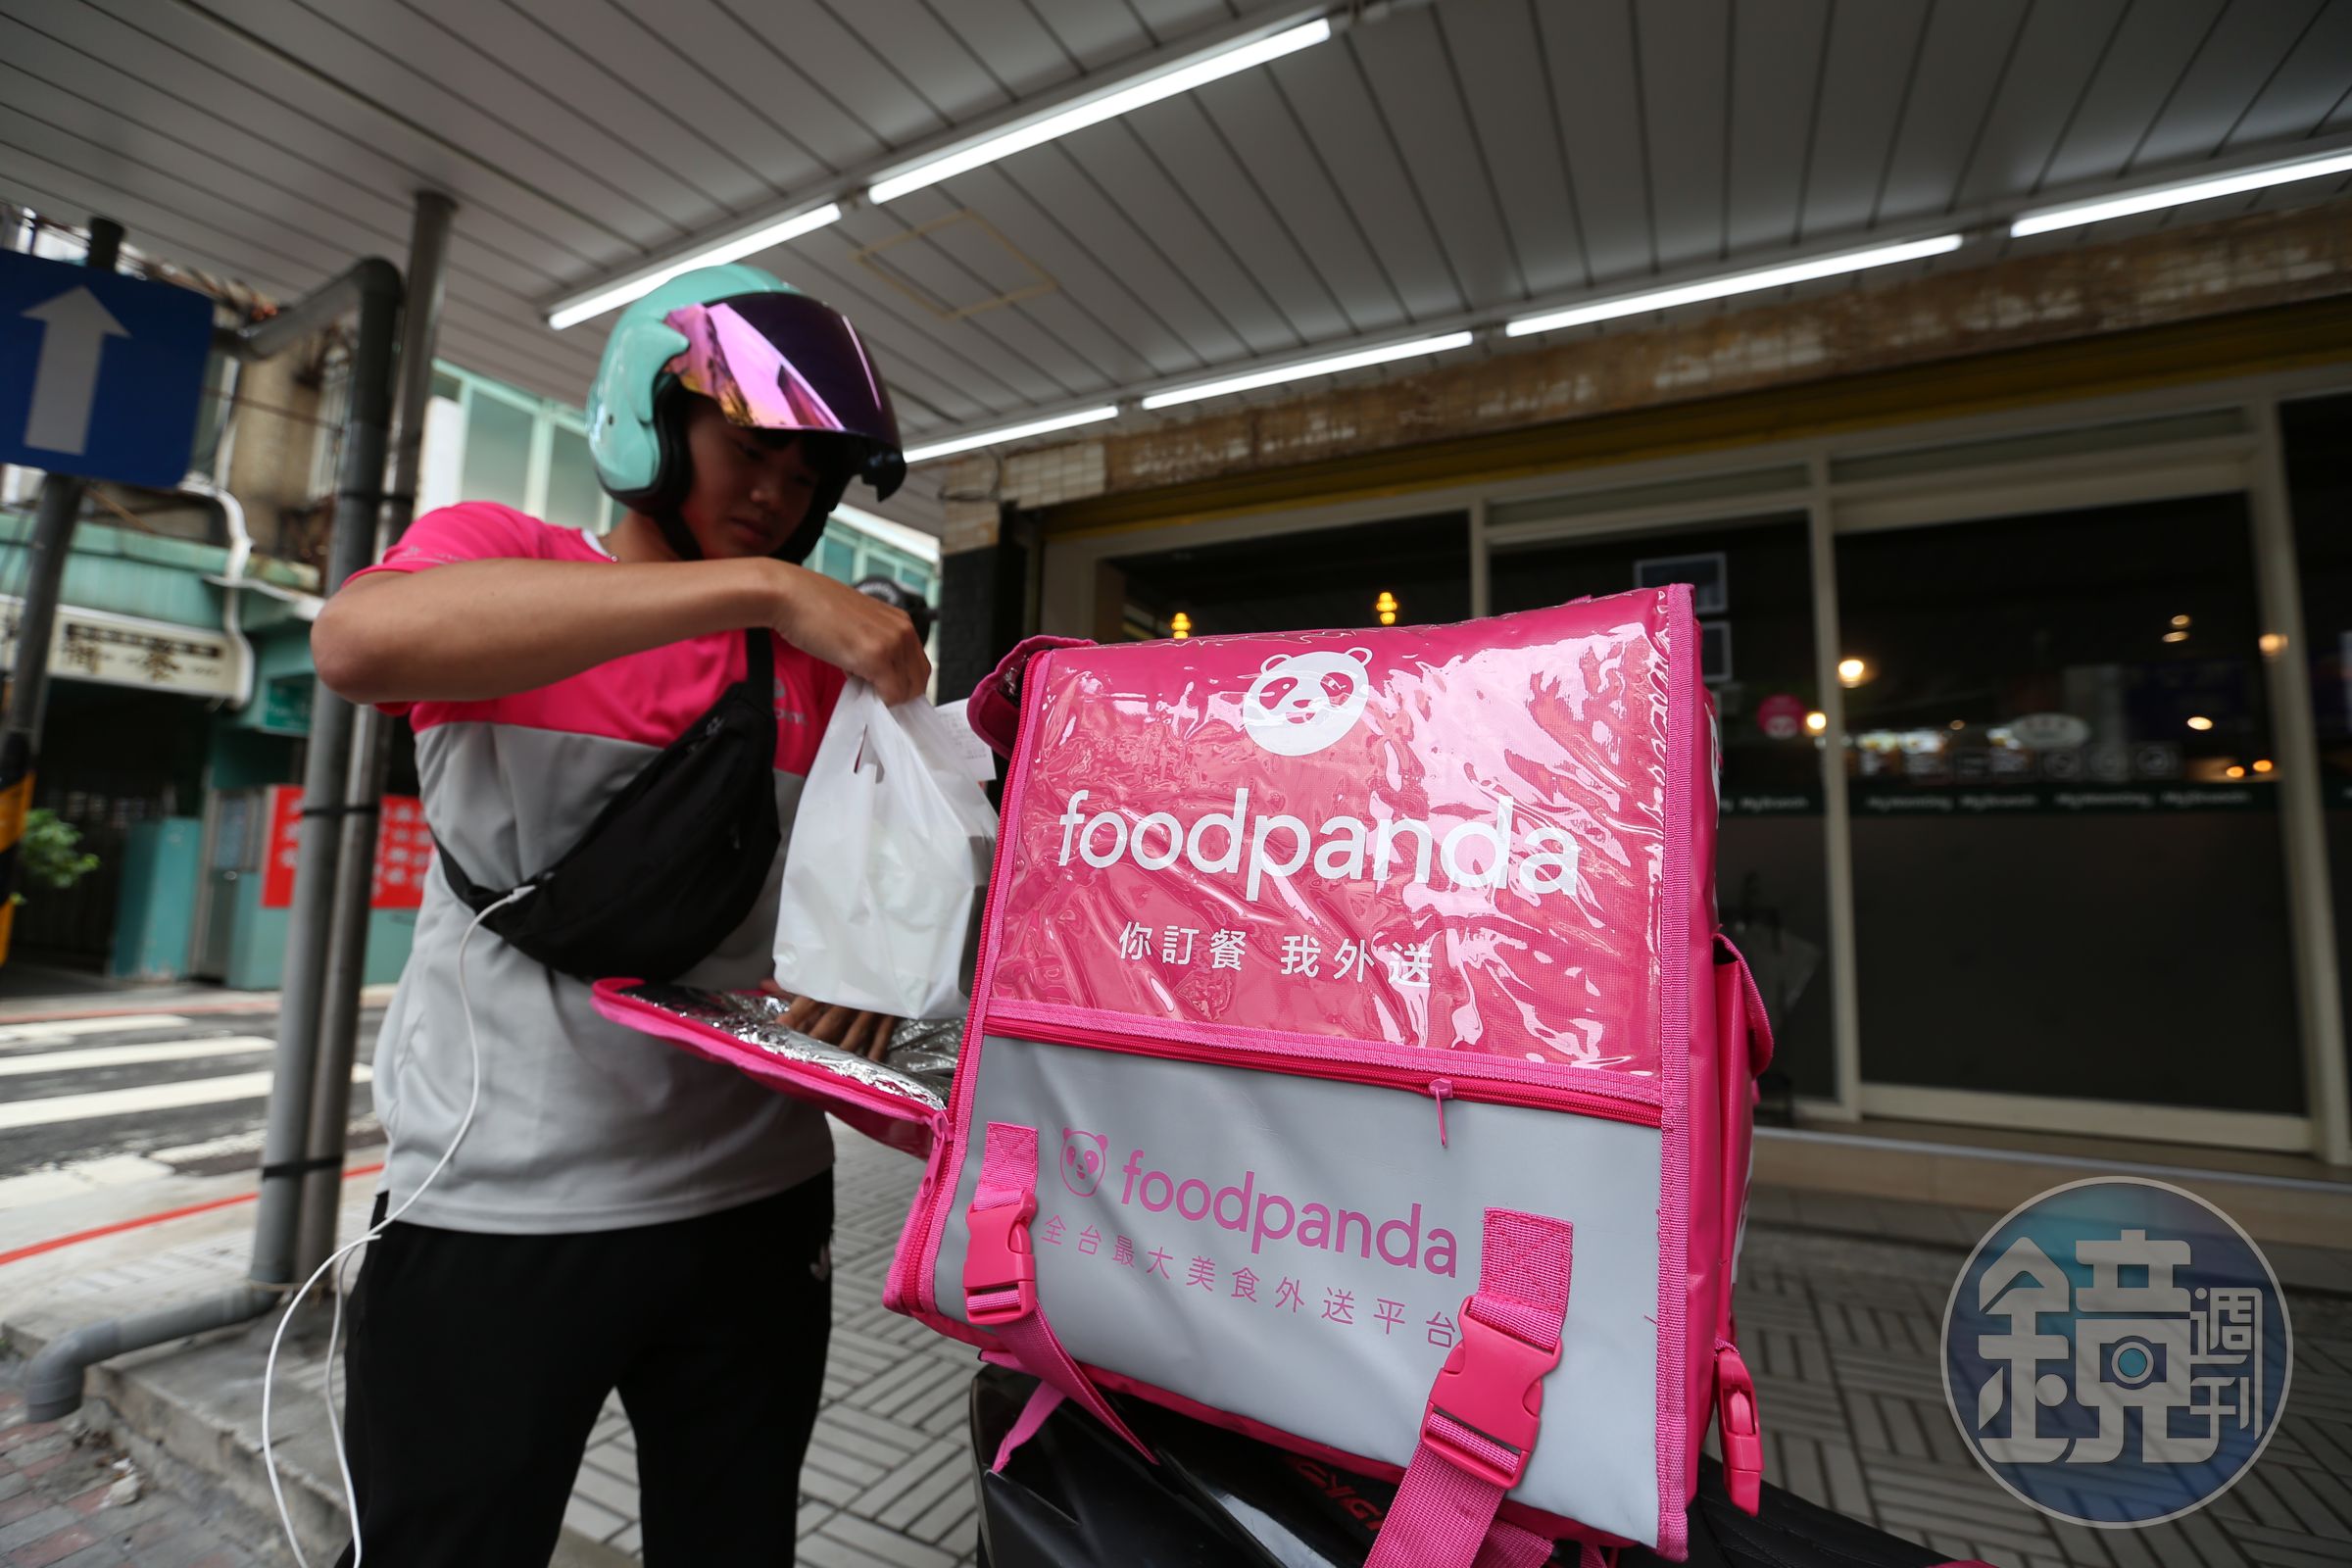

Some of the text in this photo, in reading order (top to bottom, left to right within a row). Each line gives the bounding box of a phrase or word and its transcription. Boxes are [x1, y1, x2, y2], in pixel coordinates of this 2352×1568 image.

[1057, 787, 1578, 902] foodpanda
[1119, 921, 1434, 988] 你訂餐 我外送
[1121, 1149, 1458, 1279] foodpanda
[1041, 1214, 1456, 1348] 全台最大美食外送平台
